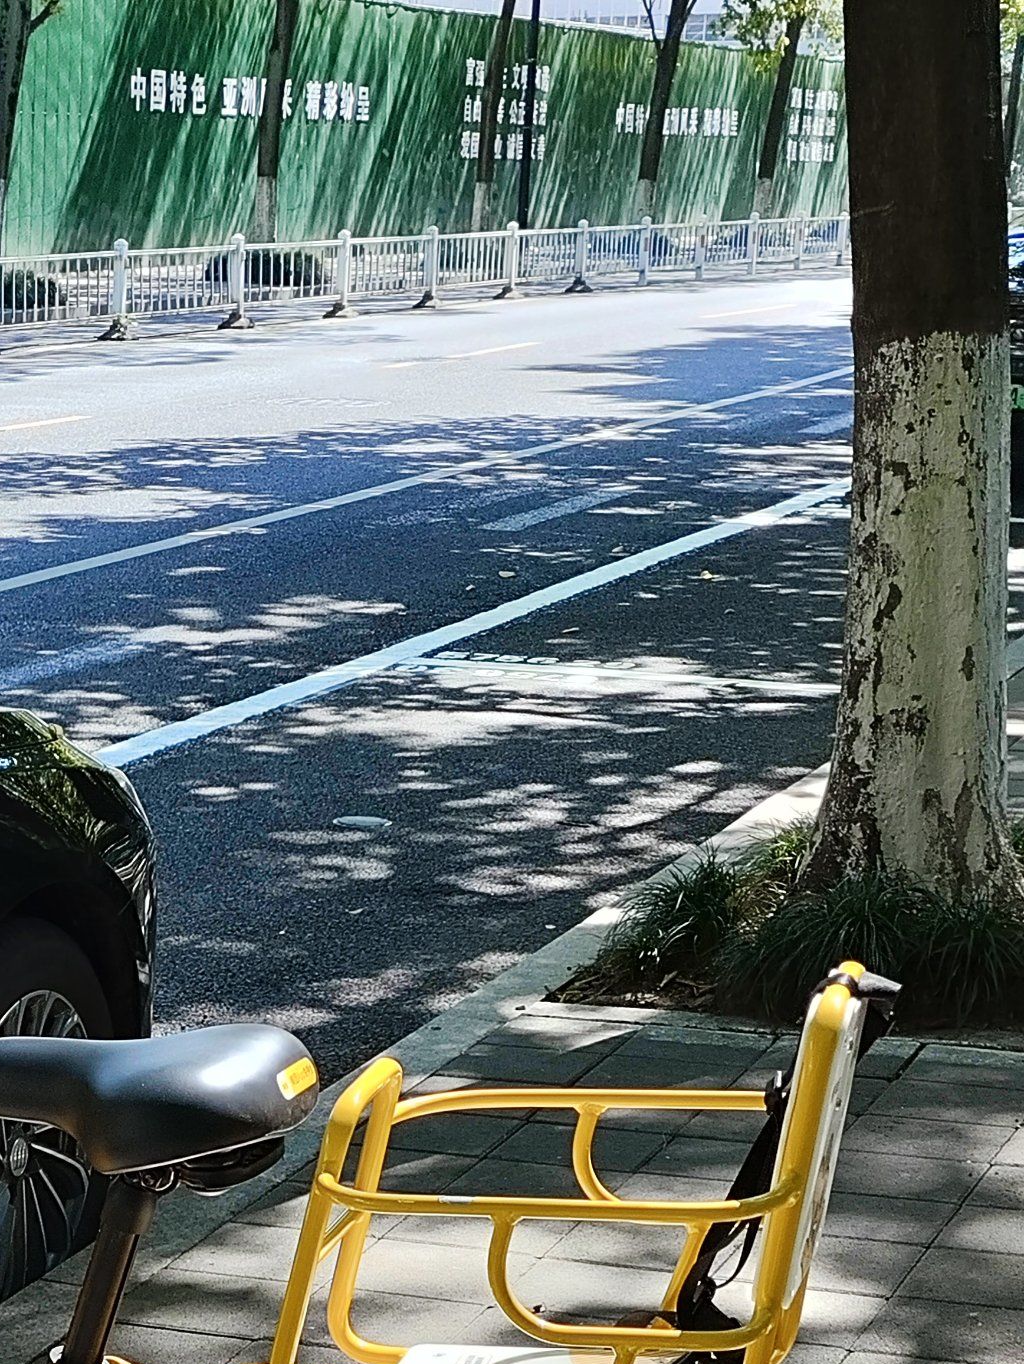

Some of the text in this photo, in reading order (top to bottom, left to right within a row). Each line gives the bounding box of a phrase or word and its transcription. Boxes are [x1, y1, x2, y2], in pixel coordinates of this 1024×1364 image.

[130, 67, 370, 121] 中国特色 亚洲采 精彩纷呈
[616, 101, 651, 135] 中国特
